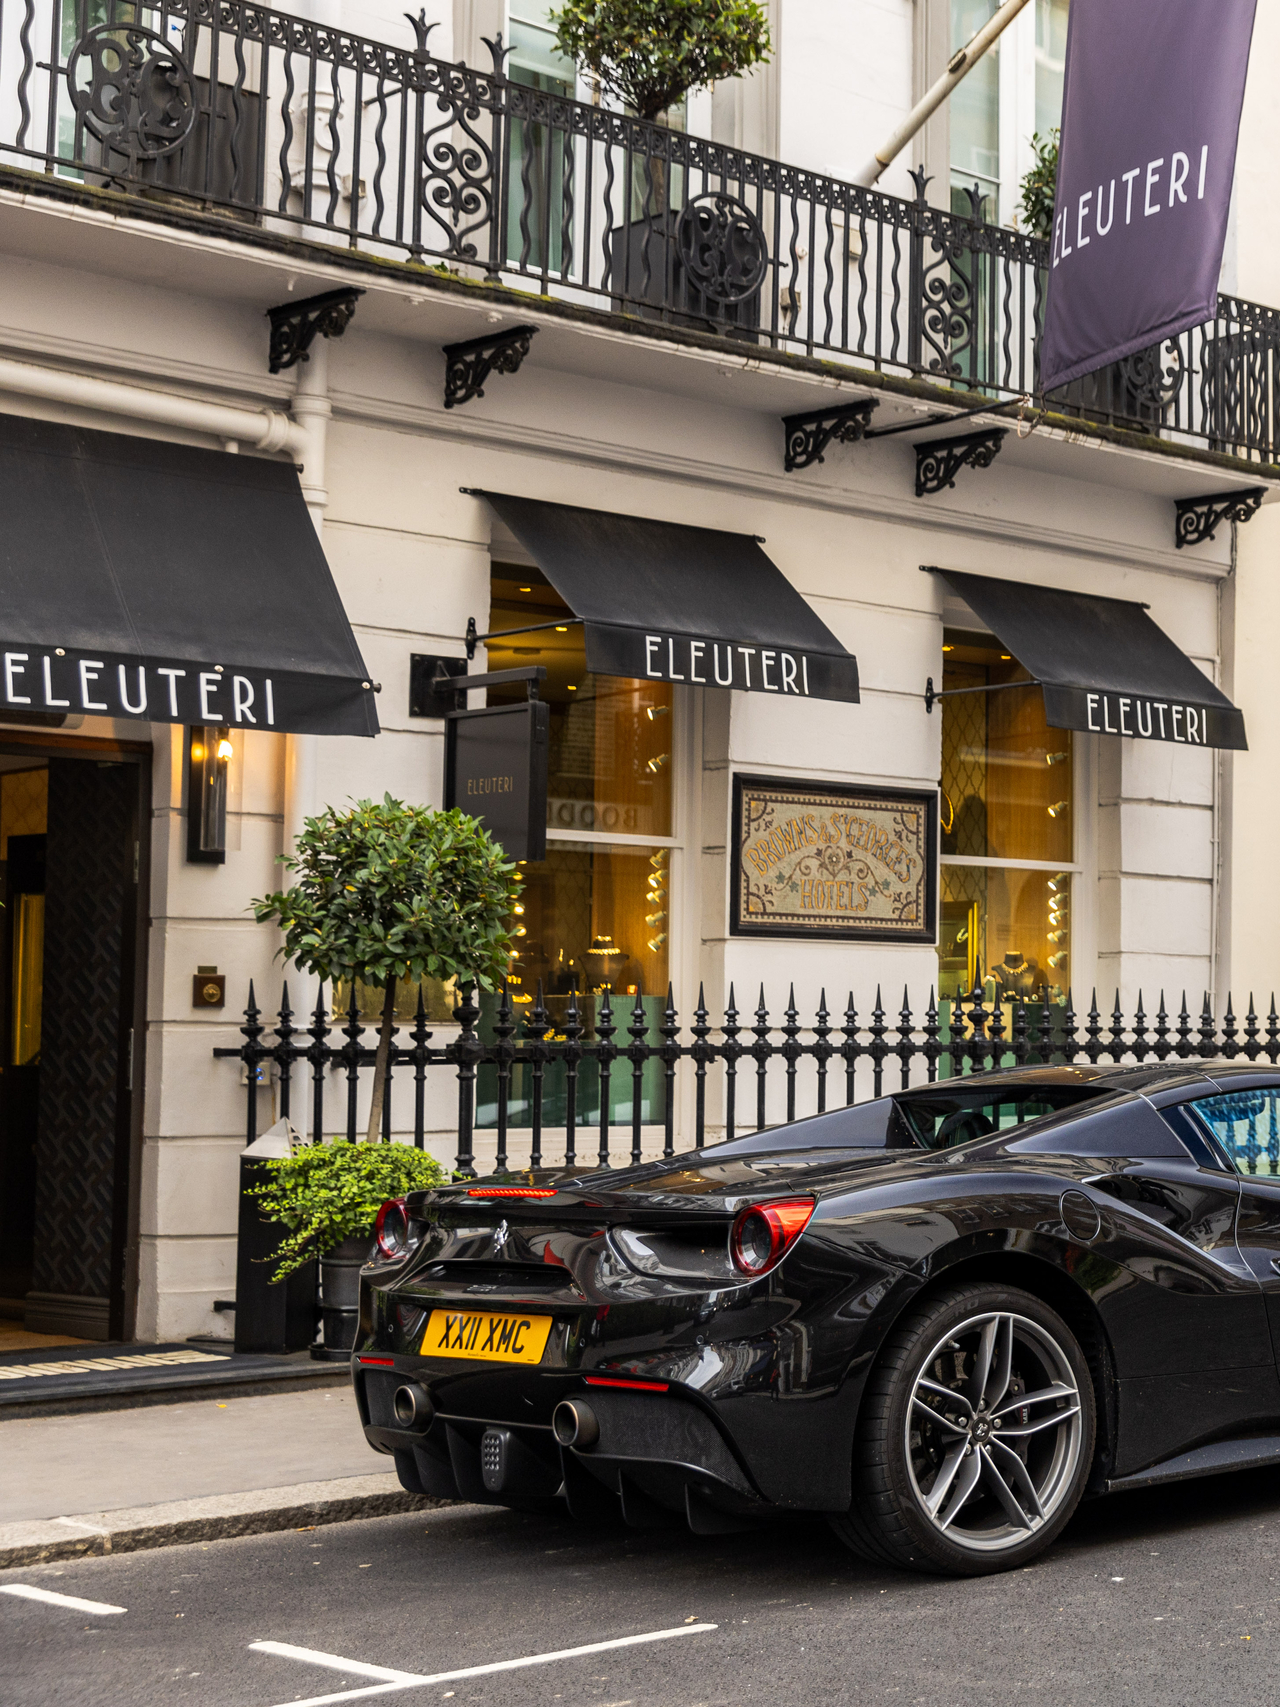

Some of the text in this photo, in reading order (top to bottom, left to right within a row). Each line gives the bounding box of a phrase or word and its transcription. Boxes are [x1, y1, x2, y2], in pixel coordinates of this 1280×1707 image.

[1053, 145, 1208, 269] ELEUTERI
[5, 653, 275, 725] ELEUTERI
[645, 635, 810, 695] ELEUTERI
[1086, 693, 1207, 744] ELEUTERI
[467, 776, 513, 795] ELEUTERI
[746, 814, 818, 877] BROWNS
[819, 822, 831, 844] &
[845, 815, 916, 883] GEORGES
[800, 879, 869, 912] HOTELS
[481, 1318, 531, 1354] XMC
